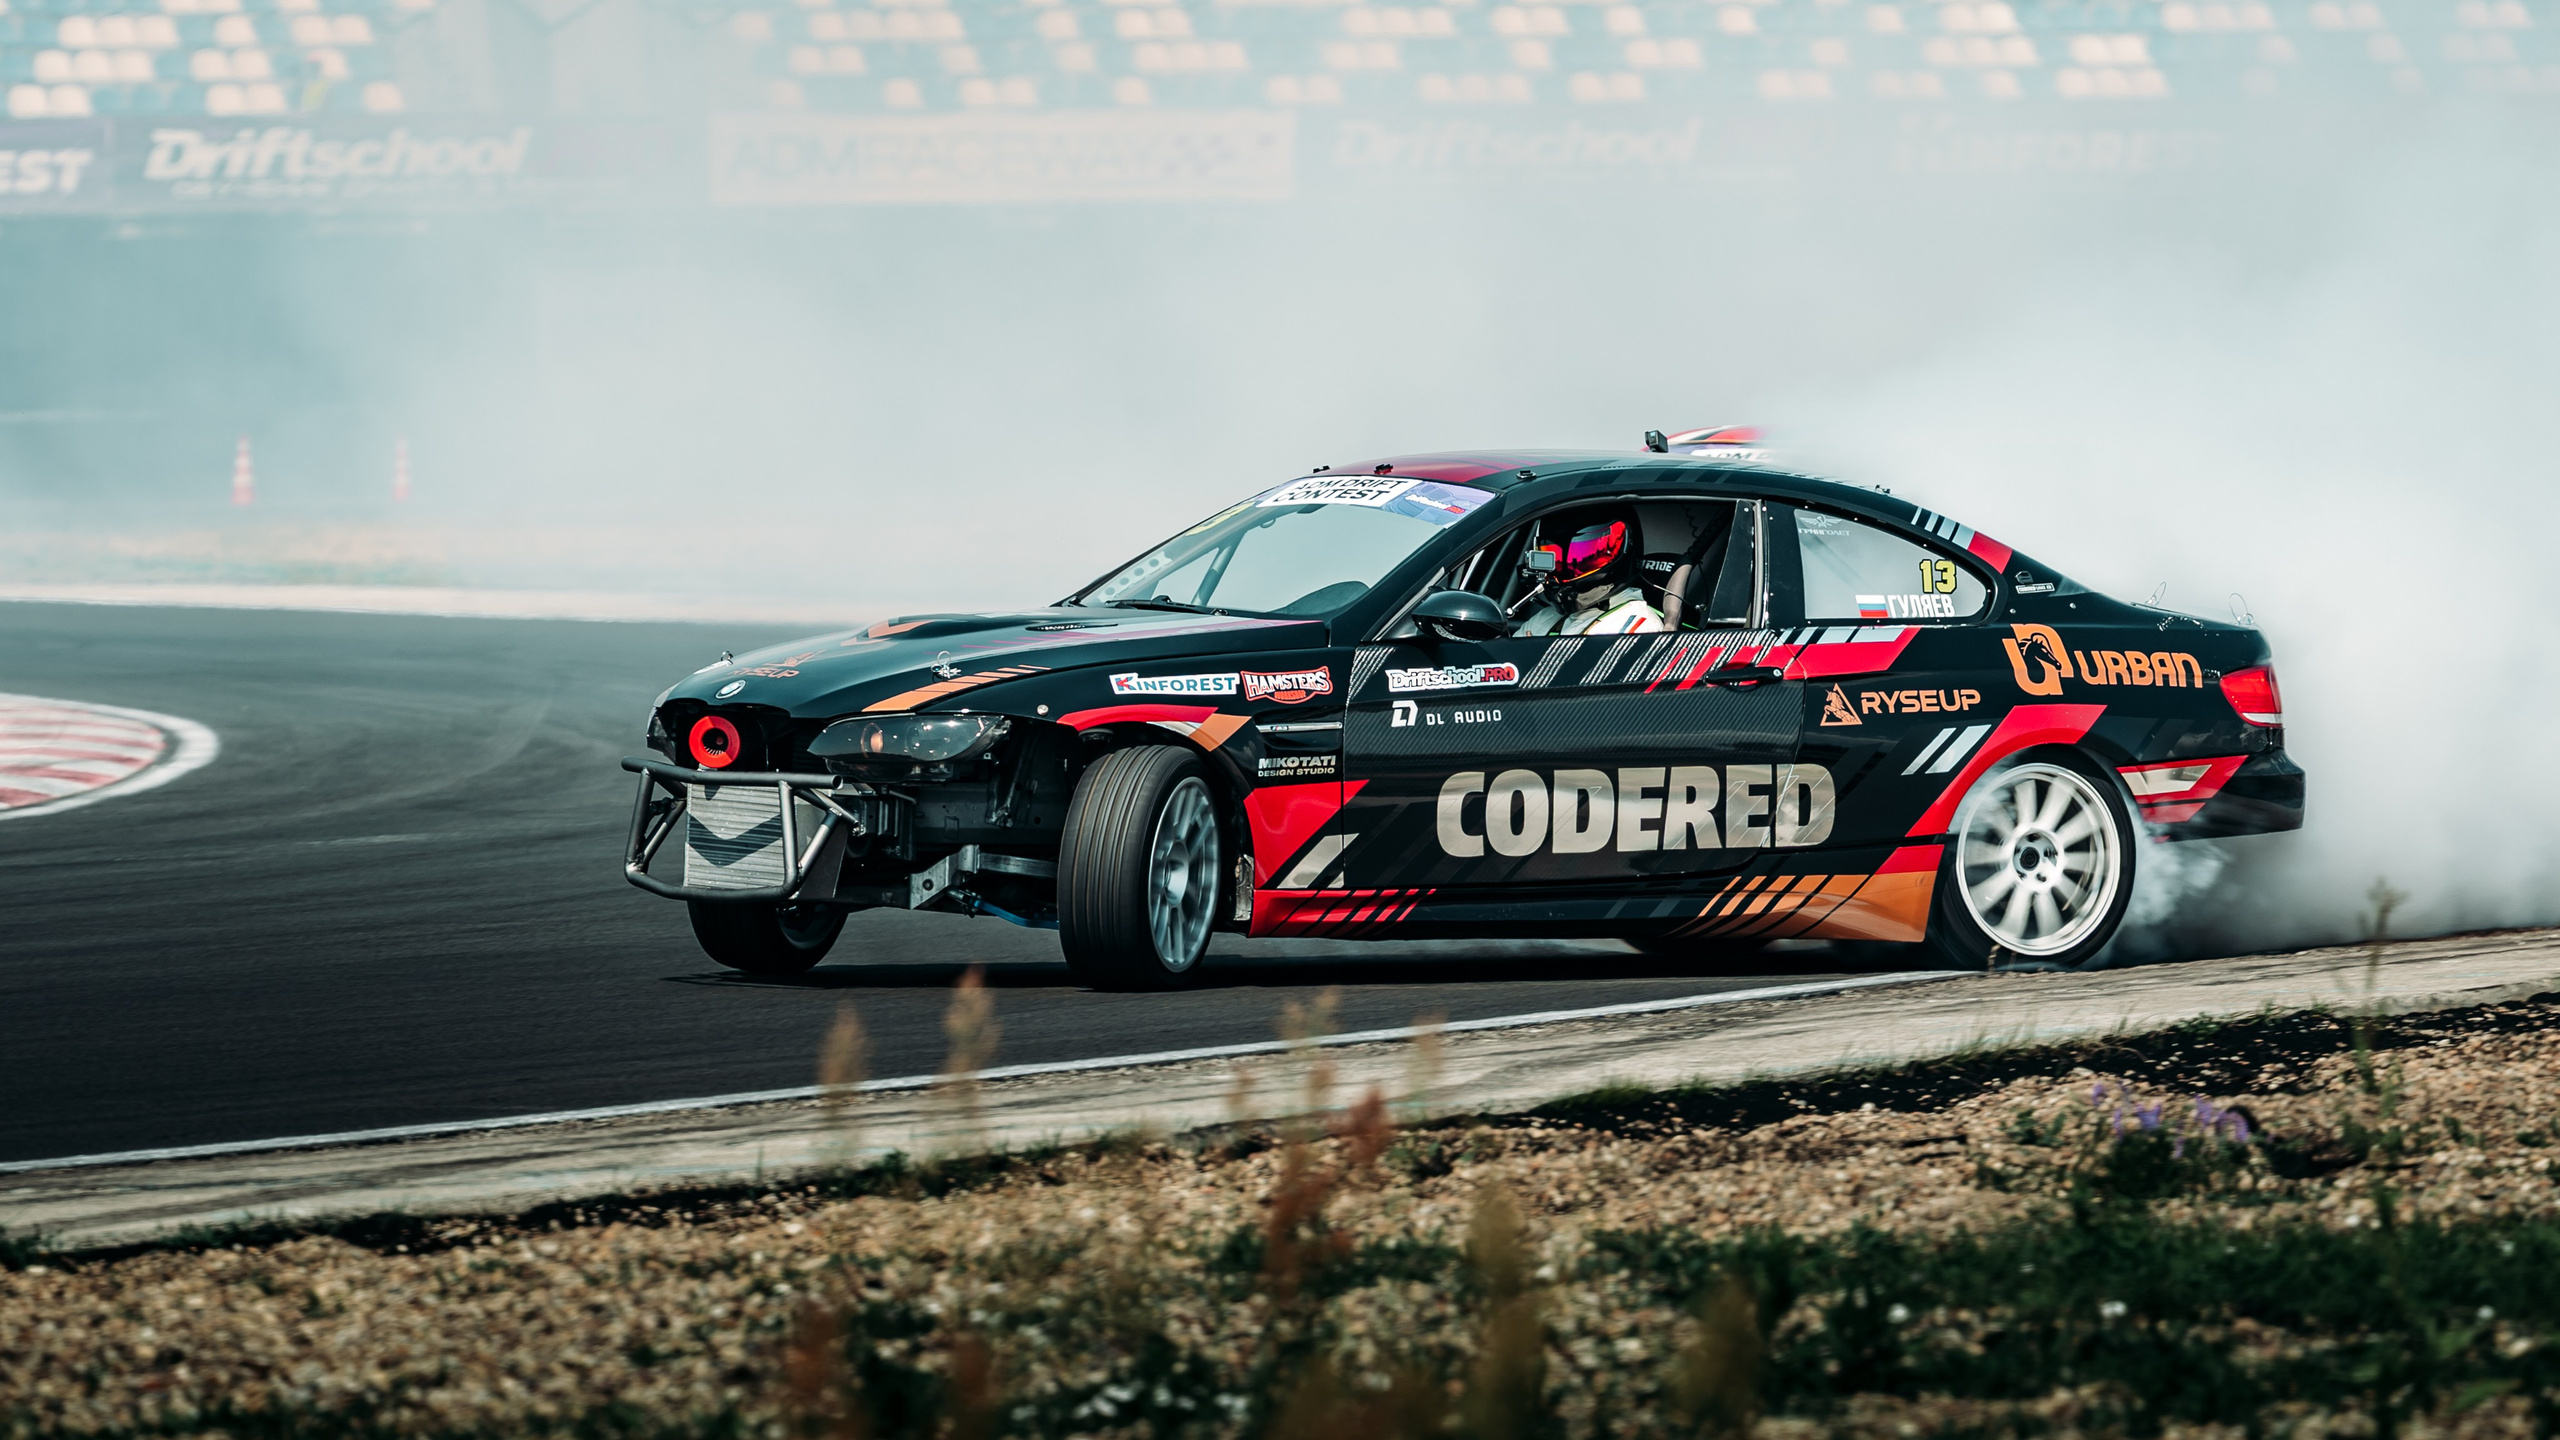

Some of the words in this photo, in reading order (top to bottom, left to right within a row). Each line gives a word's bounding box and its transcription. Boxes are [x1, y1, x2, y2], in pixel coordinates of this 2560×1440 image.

[1339, 479, 1408, 489] DRIFT
[1272, 488, 1391, 502] CONTEST
[1919, 558, 1957, 594] 13
[1887, 594, 1956, 618] ГУЛЯЕВ
[2073, 650, 2203, 689] URBAN
[1114, 676, 1236, 692] KINFOREST
[1244, 671, 1330, 698] HAMSTERS
[1860, 689, 1981, 715] RYSEUP
[1426, 713, 1445, 726] DL
[1454, 709, 1502, 724] AUDIO
[1258, 755, 1337, 769] MIKOTATI
[1258, 769, 1294, 778] DESIGN
[1296, 767, 1335, 776] STUDIO
[1437, 763, 1836, 858] CODERED
